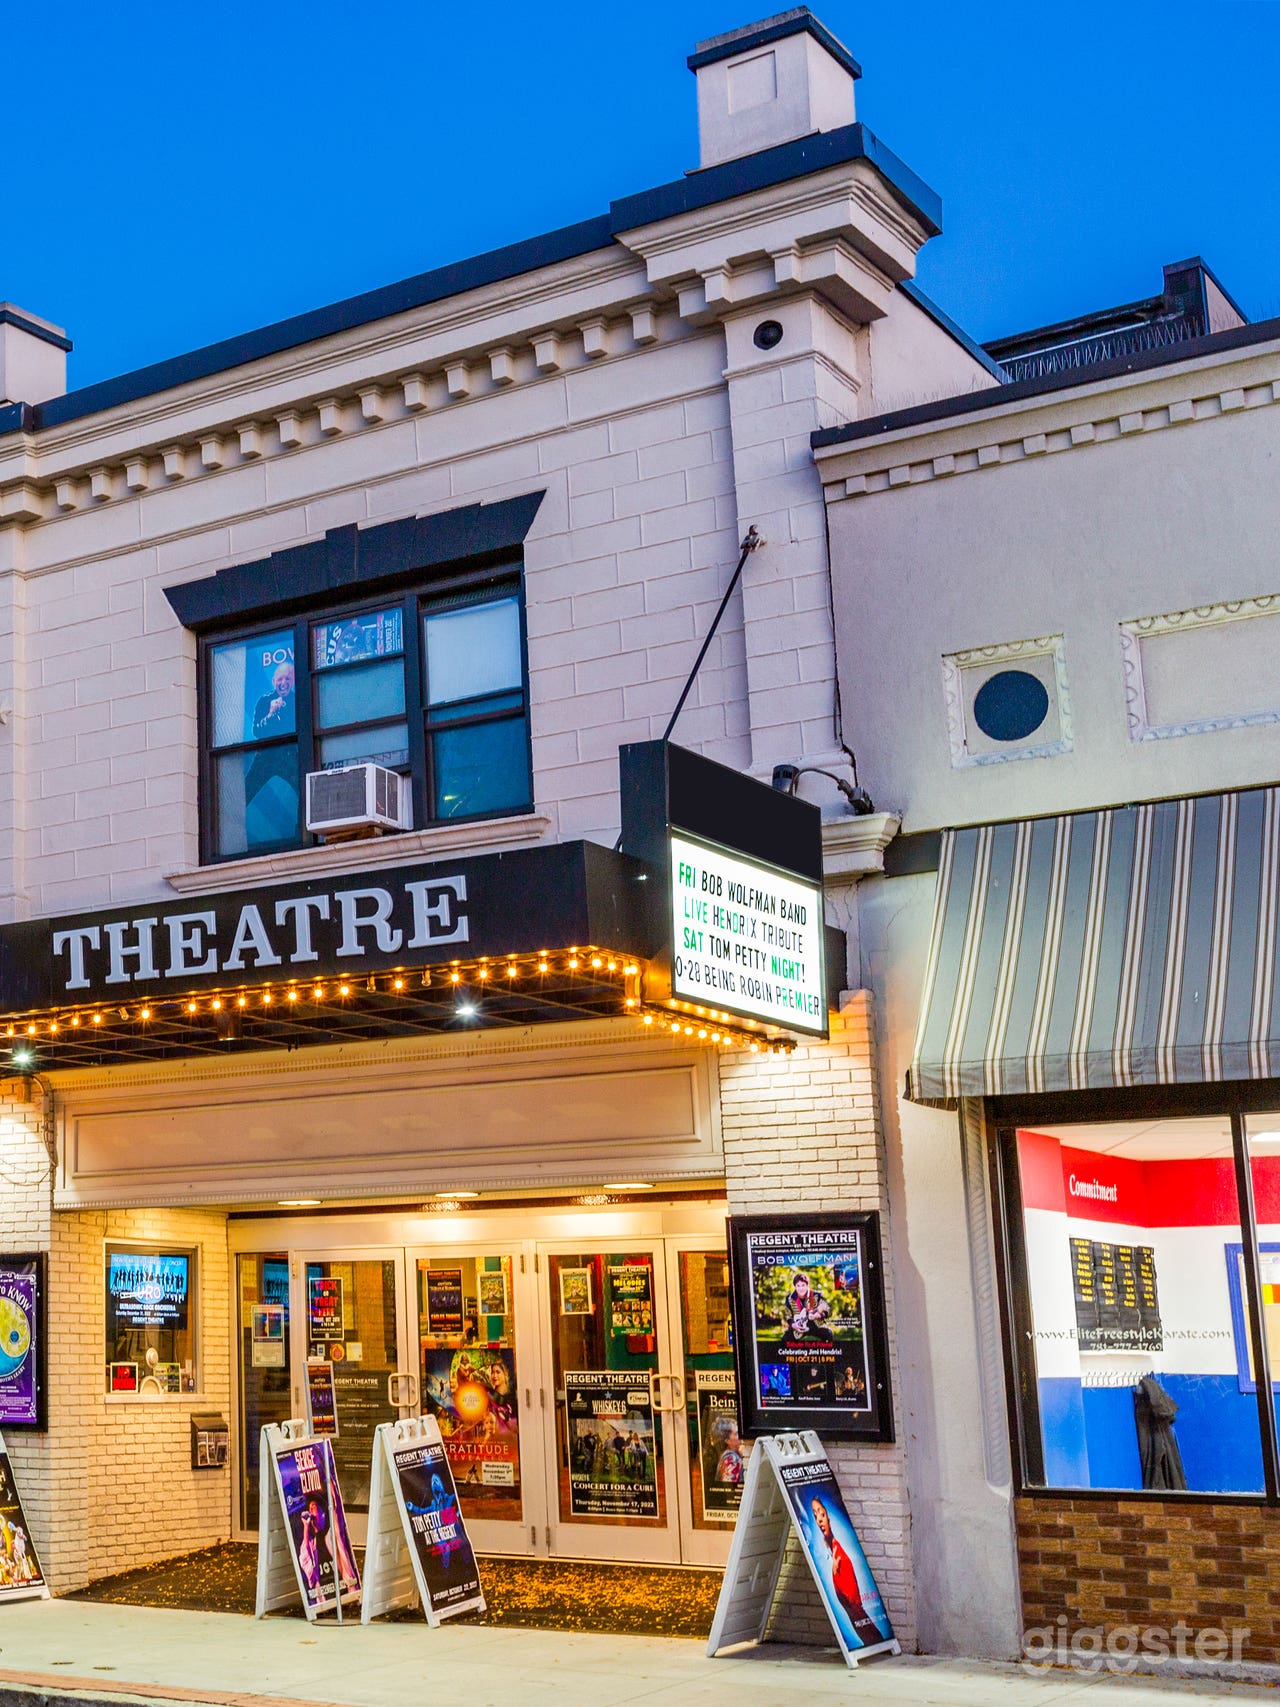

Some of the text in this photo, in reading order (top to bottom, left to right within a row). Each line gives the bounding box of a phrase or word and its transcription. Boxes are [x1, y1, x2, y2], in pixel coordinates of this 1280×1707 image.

[679, 862, 807, 925] FRI BOB WOLFMAN BAND
[53, 875, 469, 989] THEATRE
[684, 896, 803, 953] LIVE HENDRIX TRIBUTE
[683, 927, 805, 983] SAT TOM PETTY NIGHT!
[704, 965, 735, 992] BEING
[740, 975, 772, 1003] ROBIN
[776, 986, 820, 1016] PREMIER
[1070, 1174, 1118, 1202] Commitment
[751, 1233, 855, 1245] REGENT THEATRE
[757, 1254, 852, 1265] BOB WOLFMAN
[7, 1285, 32, 1311] KNOW
[1026, 1327, 1231, 1345] www.EliteFreestyleKarate.com
[566, 1375, 649, 1383] REGENT THEATRE
[709, 1394, 737, 1408] Bein
[395, 1446, 443, 1464] REGENT THEATRE
[782, 1463, 830, 1479] REGENT THEATRE
[412, 1515, 426, 1533] TOM
[423, 1510, 441, 1530] PETTY
